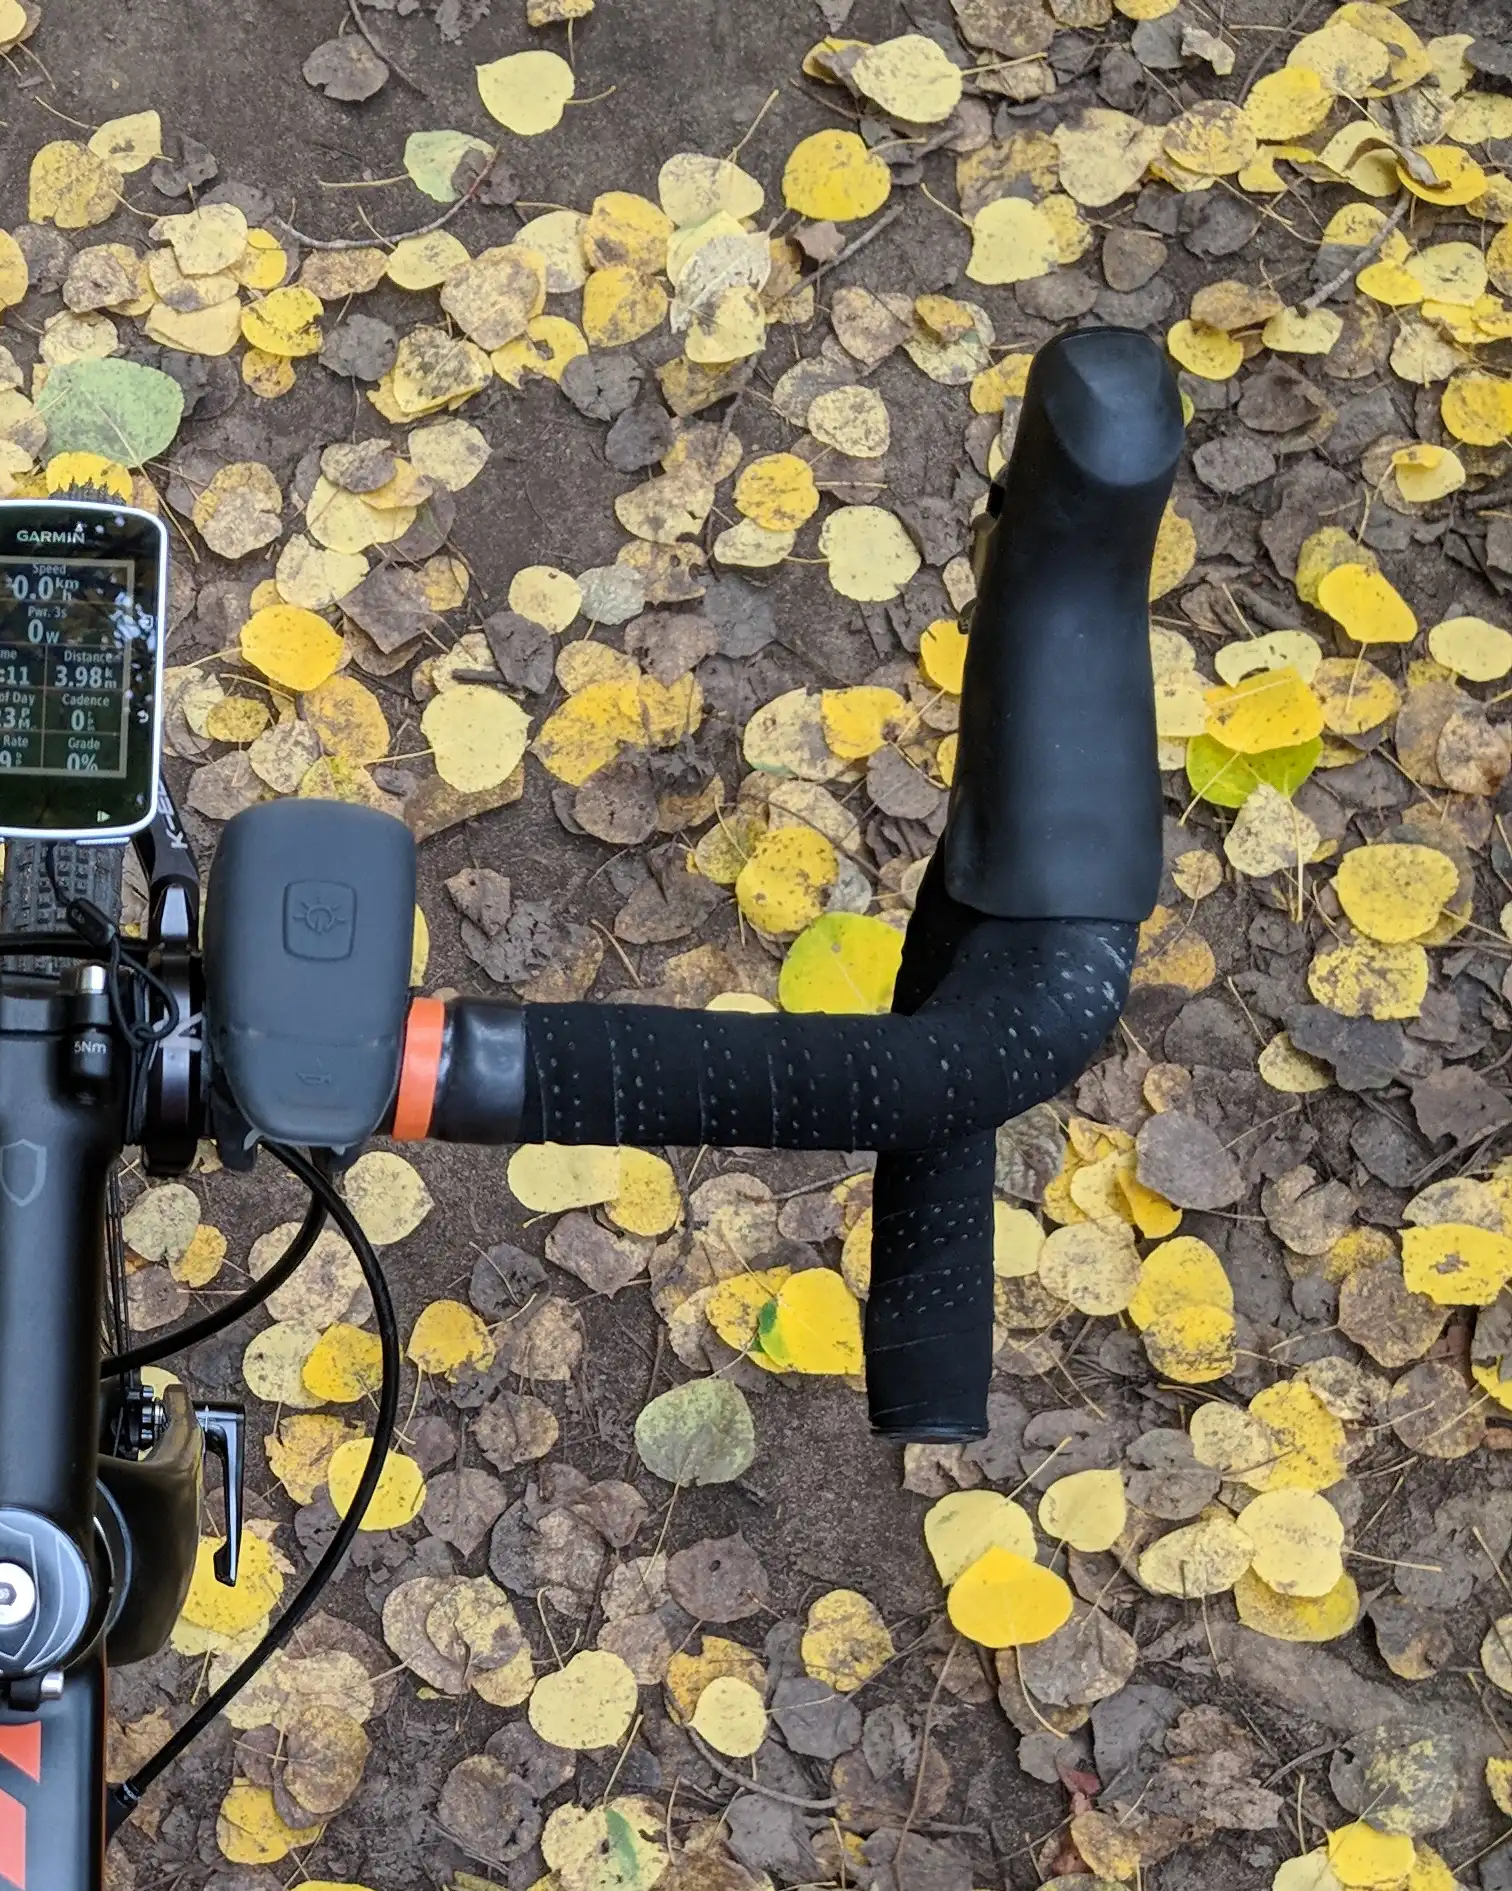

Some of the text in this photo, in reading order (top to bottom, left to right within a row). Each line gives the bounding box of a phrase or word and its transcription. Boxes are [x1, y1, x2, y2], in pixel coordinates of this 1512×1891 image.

[16, 530, 86, 544] GARMIN
[32, 563, 67, 576] Speed
[13, 574, 54, 600] 0.0
[27, 618, 44, 644] 0
[64, 650, 113, 663] Distance
[54, 665, 102, 689] 3.98
[12, 691, 36, 707] Day
[62, 693, 110, 707] Cadence
[70, 709, 85, 732] 0
[3, 734, 29, 748] Rate
[68, 737, 101, 750] Grade
